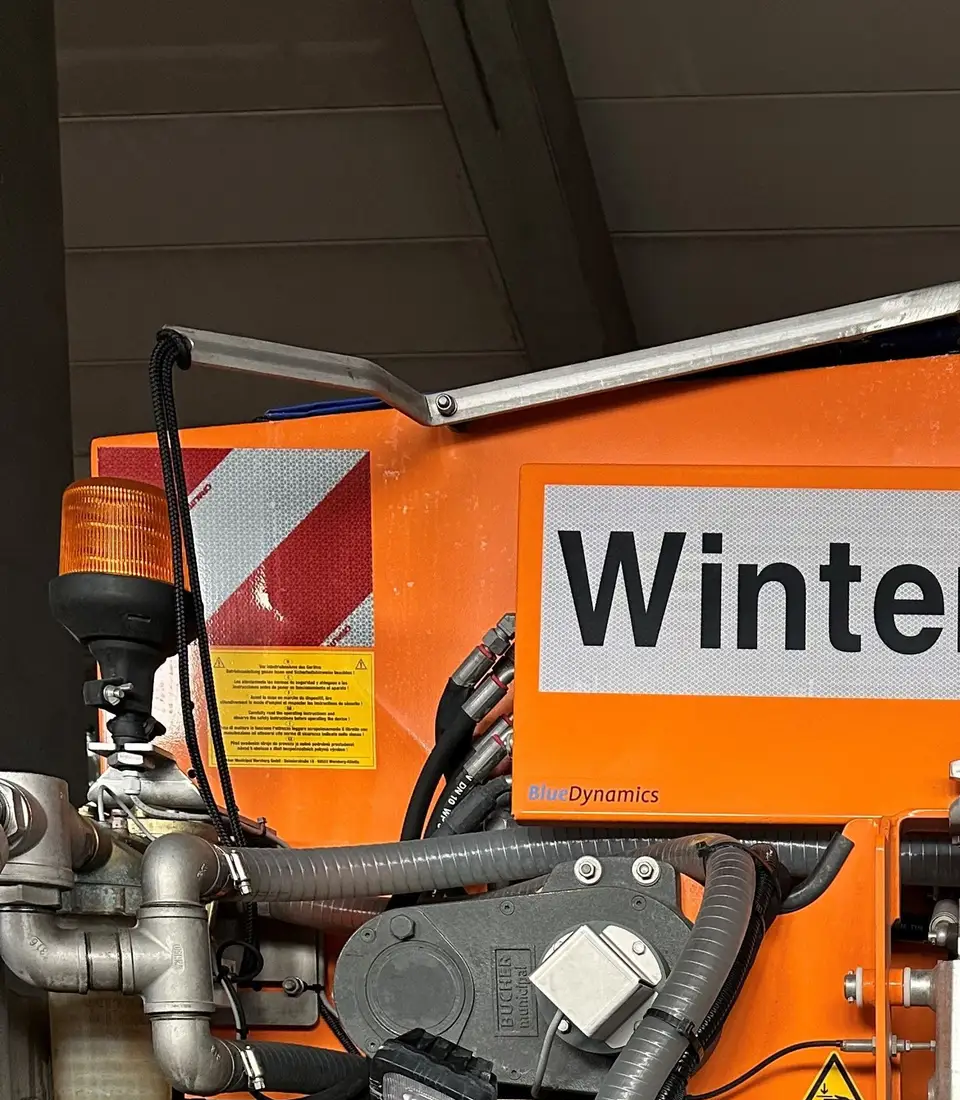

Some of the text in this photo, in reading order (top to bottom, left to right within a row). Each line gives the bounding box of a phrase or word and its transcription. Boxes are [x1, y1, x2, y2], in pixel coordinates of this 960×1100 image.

[447, 793, 459, 806] 10
[528, 785, 659, 806] BlueDynamics
[499, 953, 514, 1031] BUCHER
[518, 963, 529, 1031] municipal
